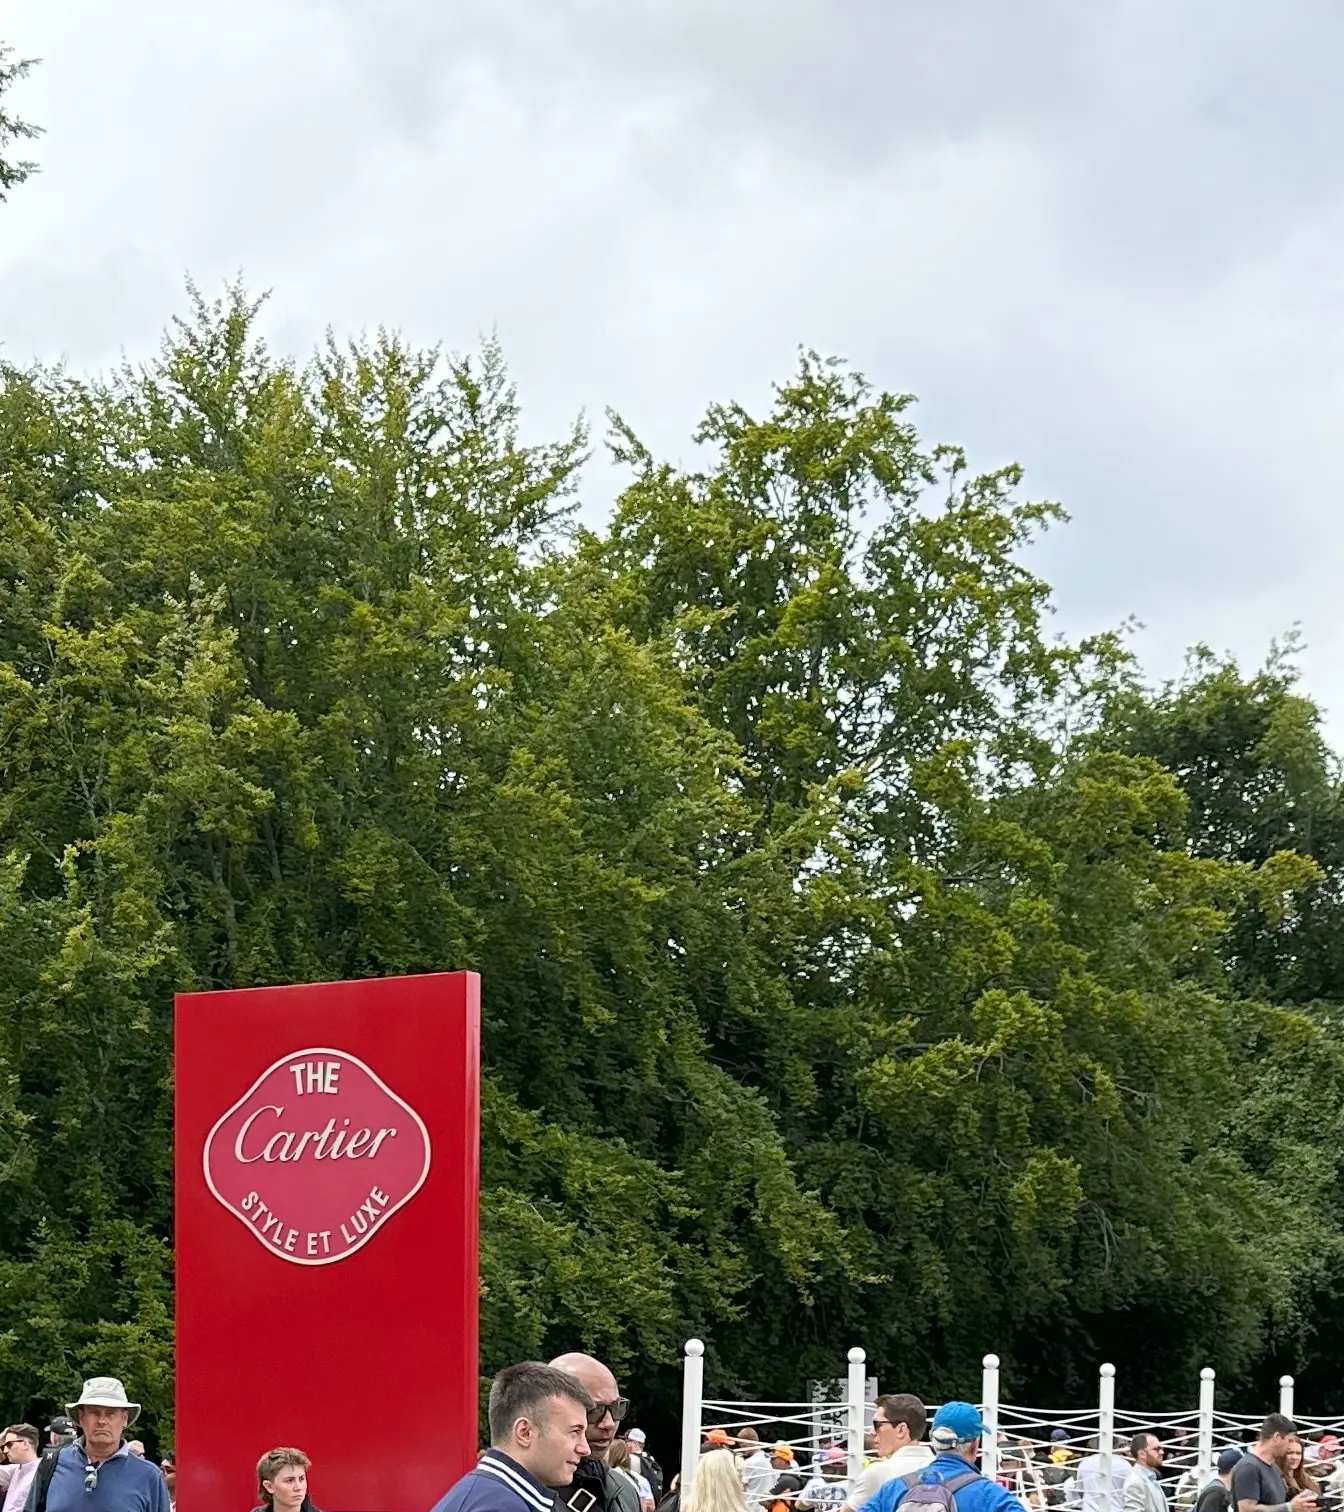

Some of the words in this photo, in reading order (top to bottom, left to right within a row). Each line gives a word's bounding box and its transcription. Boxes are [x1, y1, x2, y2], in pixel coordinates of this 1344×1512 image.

[289, 1061, 341, 1095] THE
[234, 1105, 397, 1163] Cartier
[241, 1191, 299, 1252] STYLE
[307, 1230, 331, 1255] ET
[340, 1185, 390, 1244] LUXE
